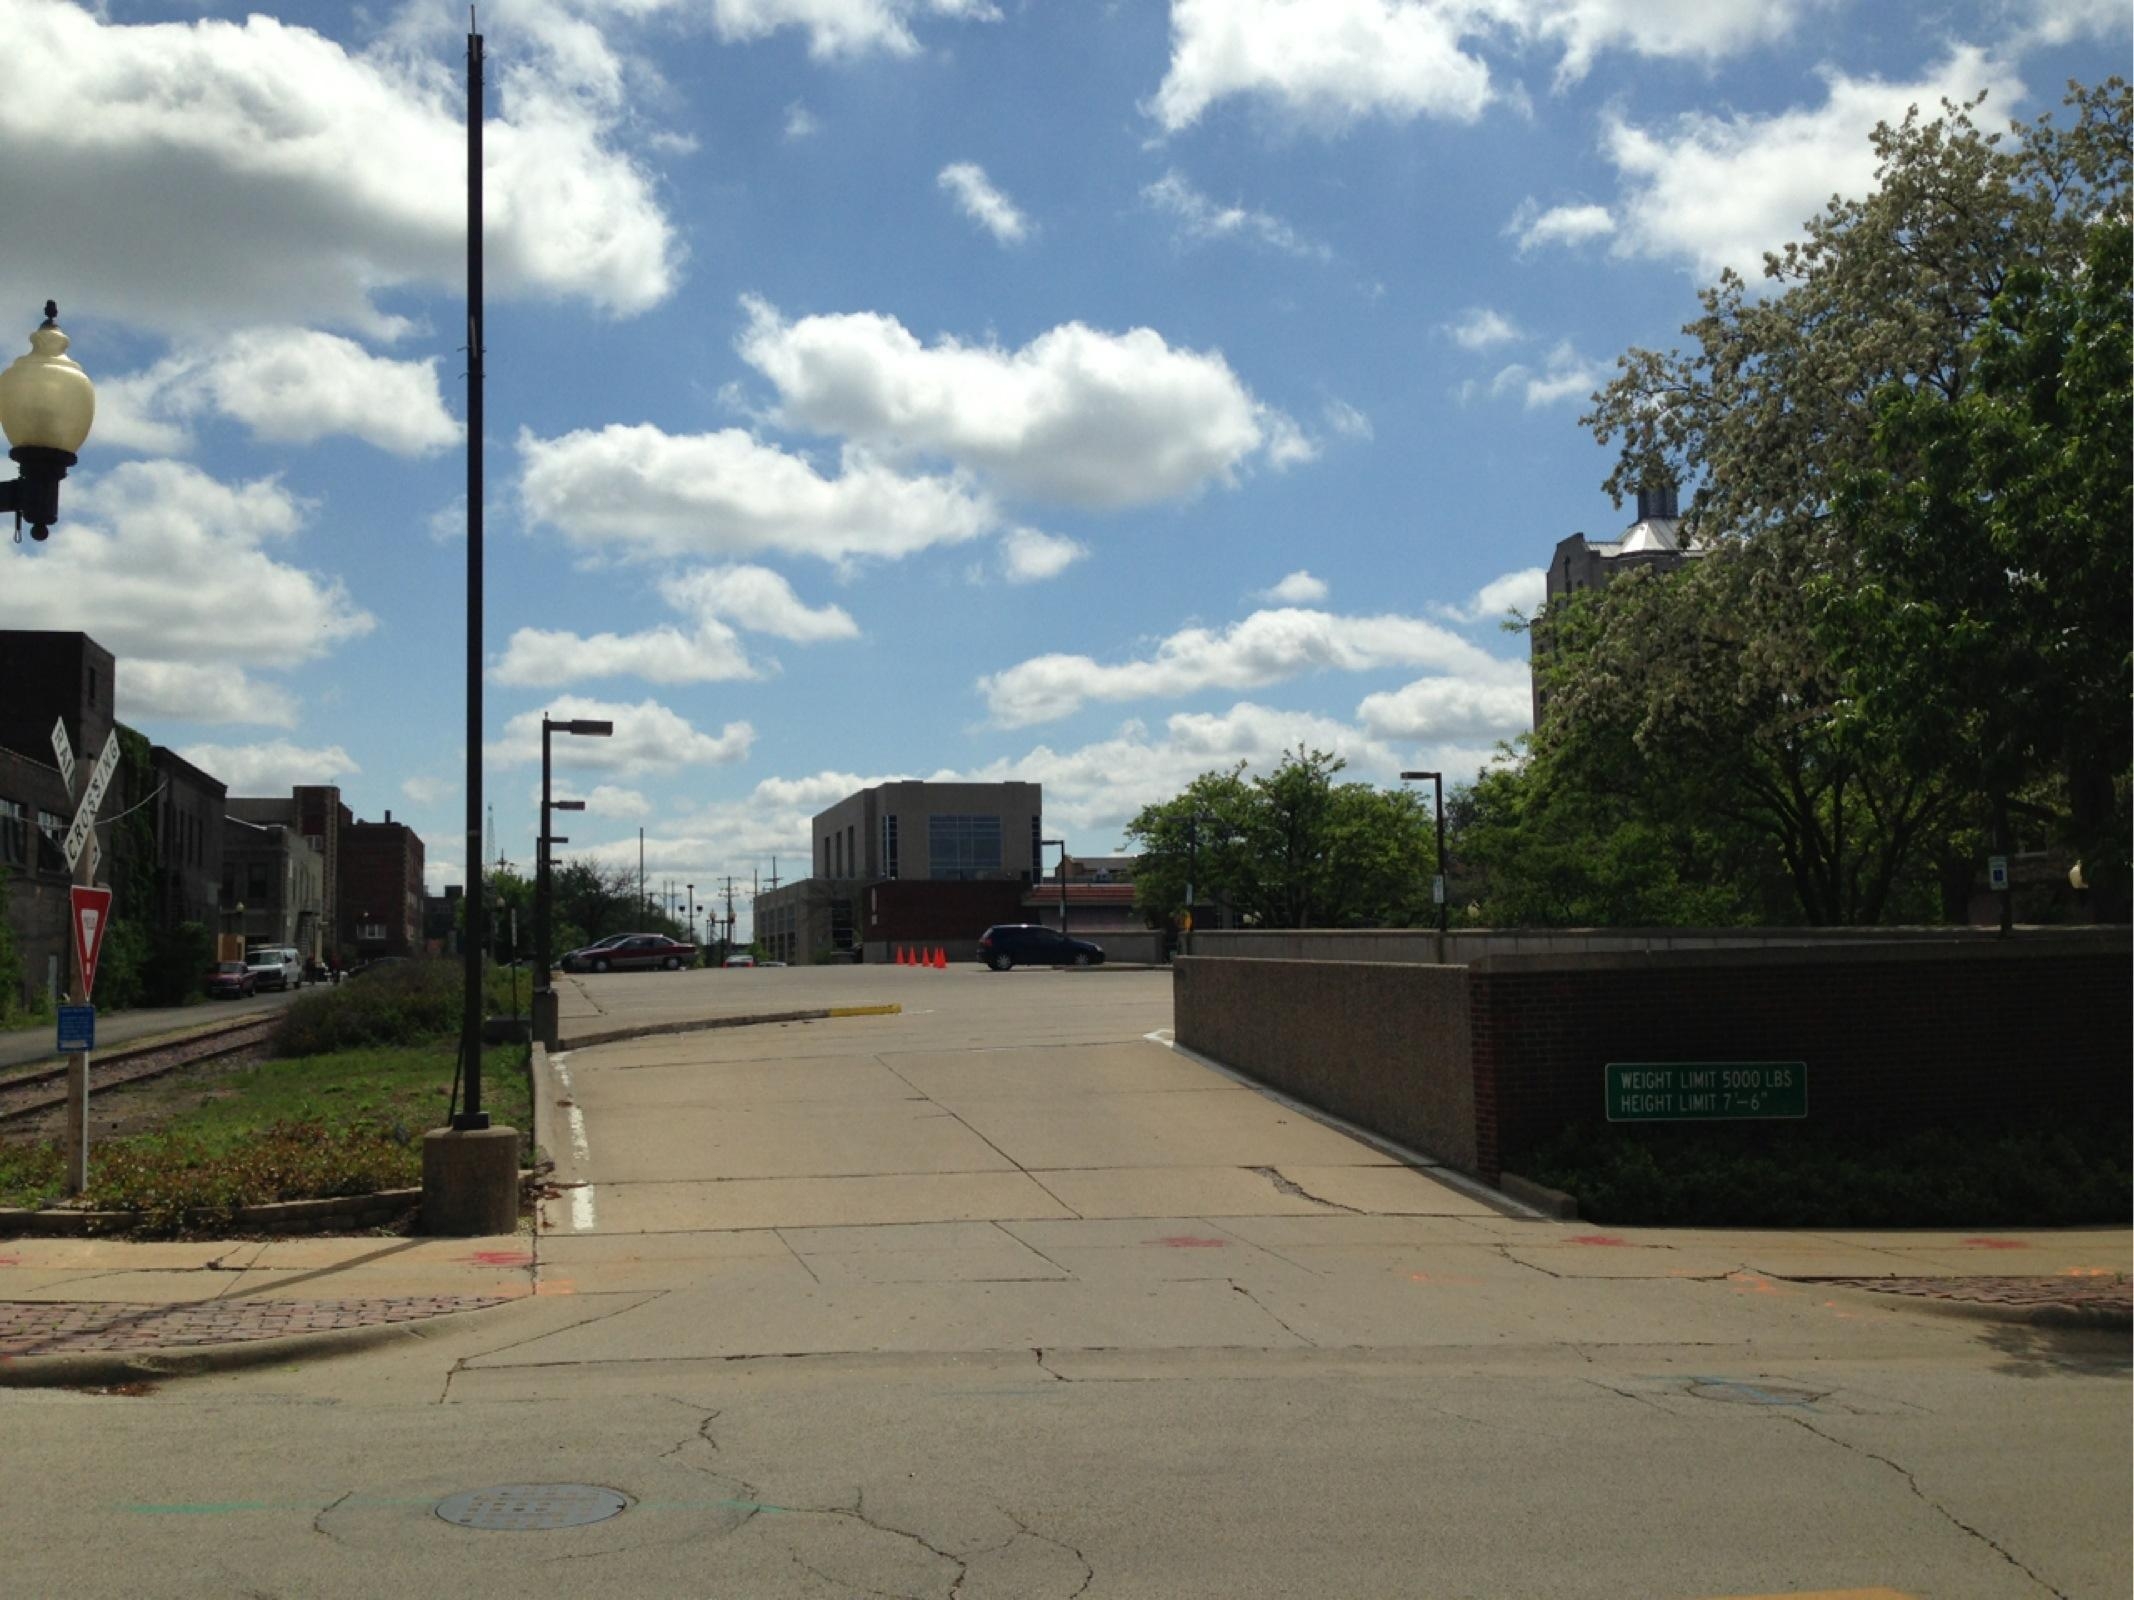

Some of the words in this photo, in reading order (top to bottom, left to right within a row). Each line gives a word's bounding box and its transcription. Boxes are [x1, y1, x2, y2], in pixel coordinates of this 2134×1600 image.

[67, 739, 117, 861] CROSSING
[1620, 1071, 1672, 1088] WEIGHT
[1680, 1071, 1716, 1088] LIMIT
[1722, 1070, 1760, 1088] 5000
[1766, 1069, 1792, 1087] LBS
[1620, 1093, 1672, 1112] HEIGHT
[1679, 1093, 1716, 1111] LIMIT
